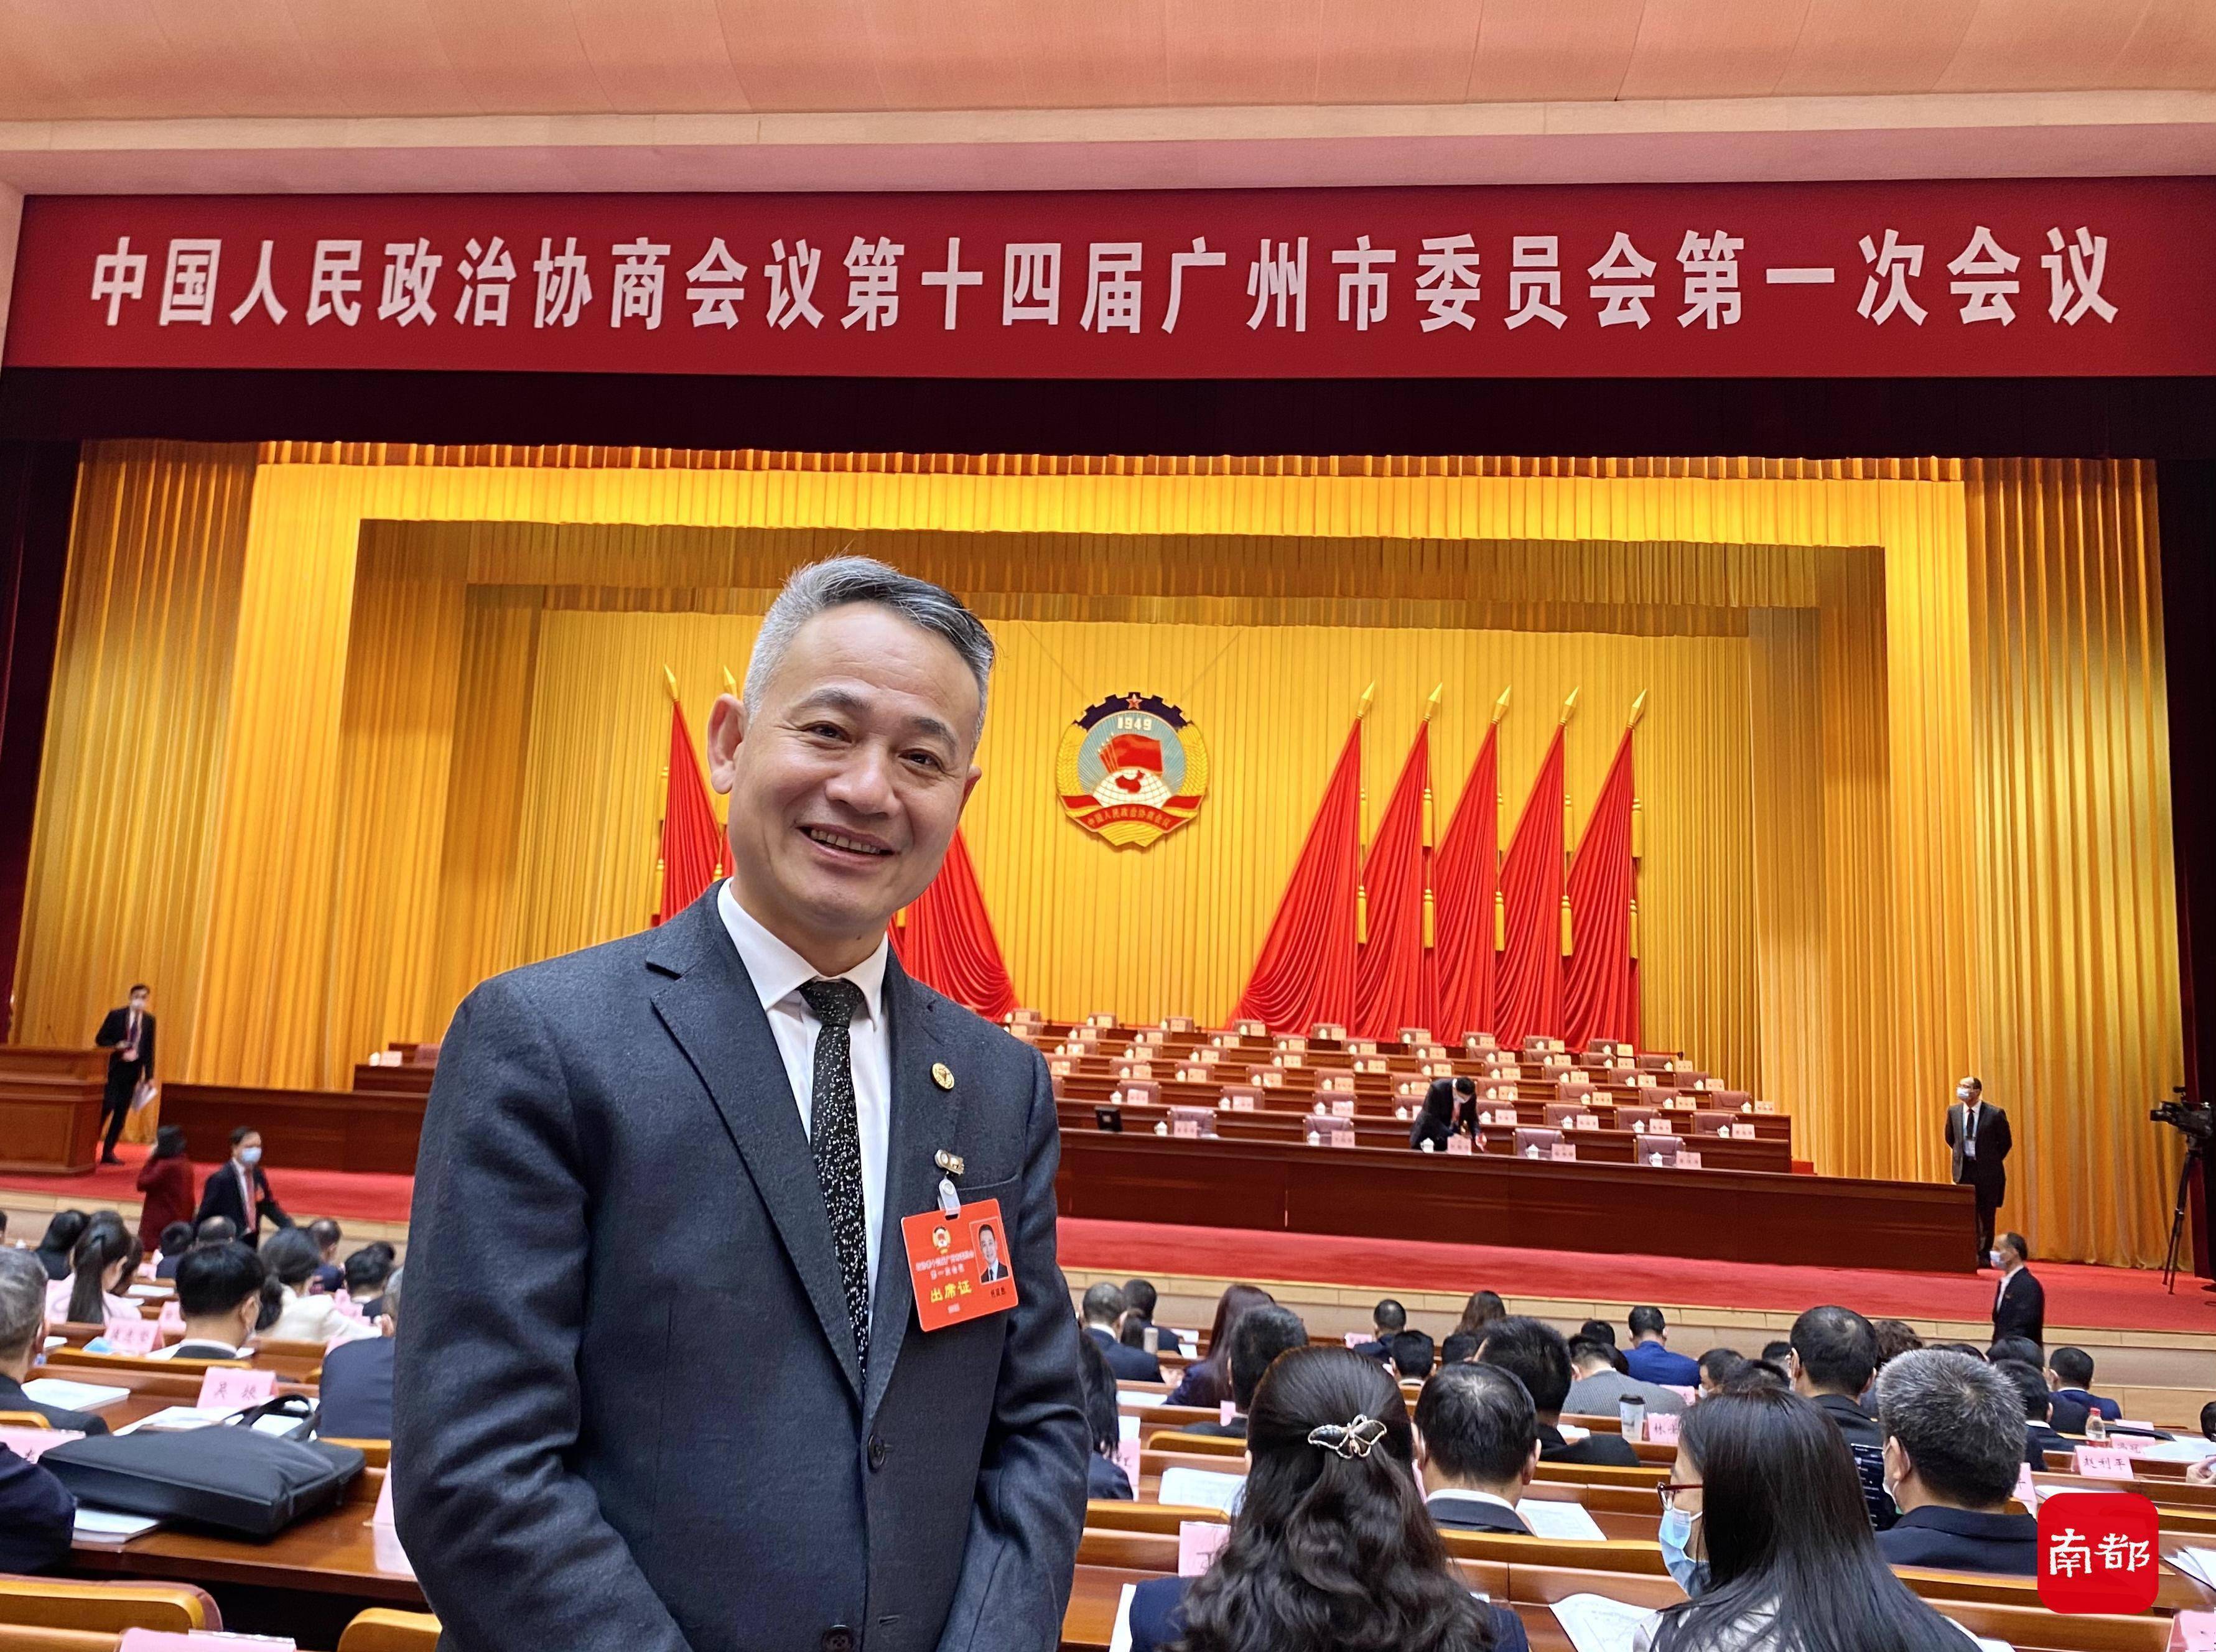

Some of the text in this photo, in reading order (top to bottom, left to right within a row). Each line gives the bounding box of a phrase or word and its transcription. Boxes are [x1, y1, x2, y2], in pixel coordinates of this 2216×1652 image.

[93, 227, 2118, 334] 中国人民政治协商会议第十四届广州市委员会第一次会议
[1117, 718, 1152, 731] 1949
[930, 1280, 972, 1303] 出席证
[2083, 1454, 2126, 1471] 赵利平
